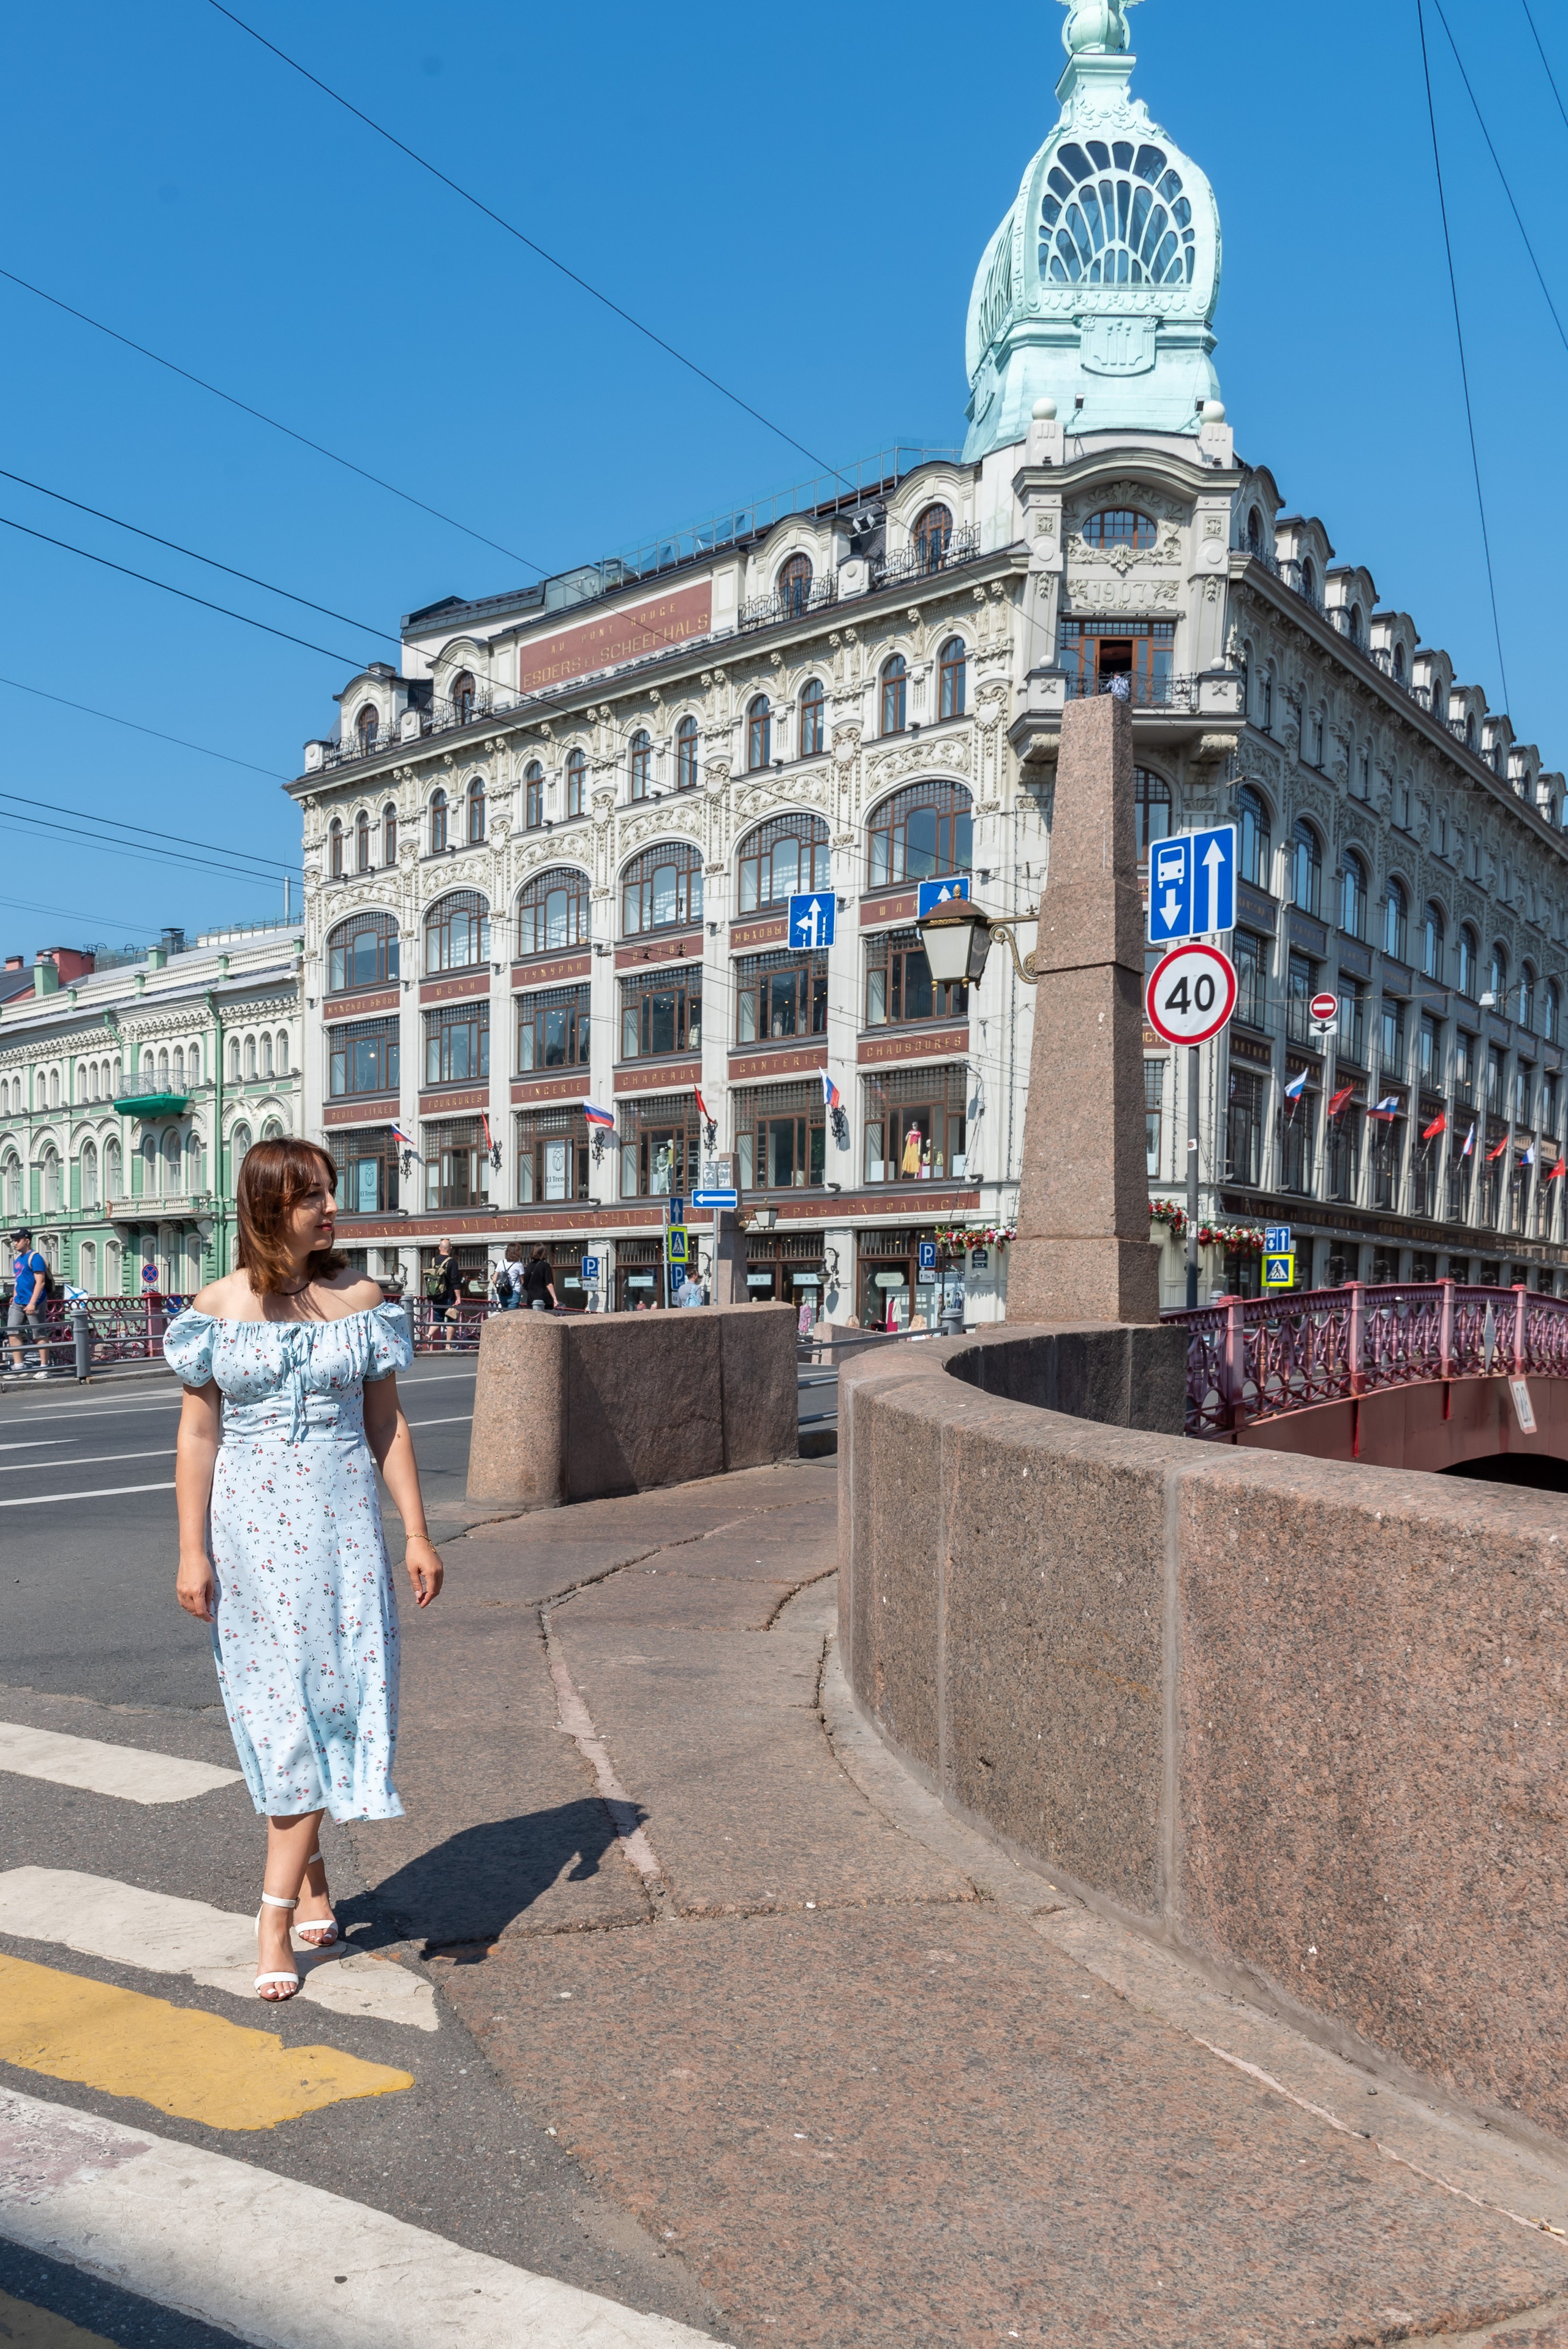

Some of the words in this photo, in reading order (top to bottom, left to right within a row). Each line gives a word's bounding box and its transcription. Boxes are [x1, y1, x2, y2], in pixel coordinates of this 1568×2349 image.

[551, 643, 564, 654] AU
[582, 625, 612, 643] PONT
[631, 603, 676, 627] ROUGE
[524, 657, 581, 688] ESDERS
[585, 656, 595, 668] ET
[601, 613, 708, 662] SCHEEFHALS
[880, 900, 918, 915] ШЛЯ
[524, 962, 581, 980] ТУЖУРКИ
[436, 982, 475, 996] ЮБКИ
[1165, 974, 1215, 1015] 40
[328, 1001, 366, 1014] МУЖСКОЕ
[867, 1036, 962, 1057] CHAUSSURES
[623, 1069, 696, 1086] CHAPEAUX
[522, 1083, 581, 1097] LINGERIE
[429, 1094, 483, 1108] FOURRURES
[332, 1110, 354, 1120] DEUIL
[364, 1105, 393, 1116] LIVREE
[847, 1199, 965, 1215] СХЕФАЛЬСЪ
[567, 1211, 653, 1227] КРАСНАГО
[924, 1246, 933, 1264] P
[587, 1259, 595, 1275] P
[676, 1266, 682, 1286] P
